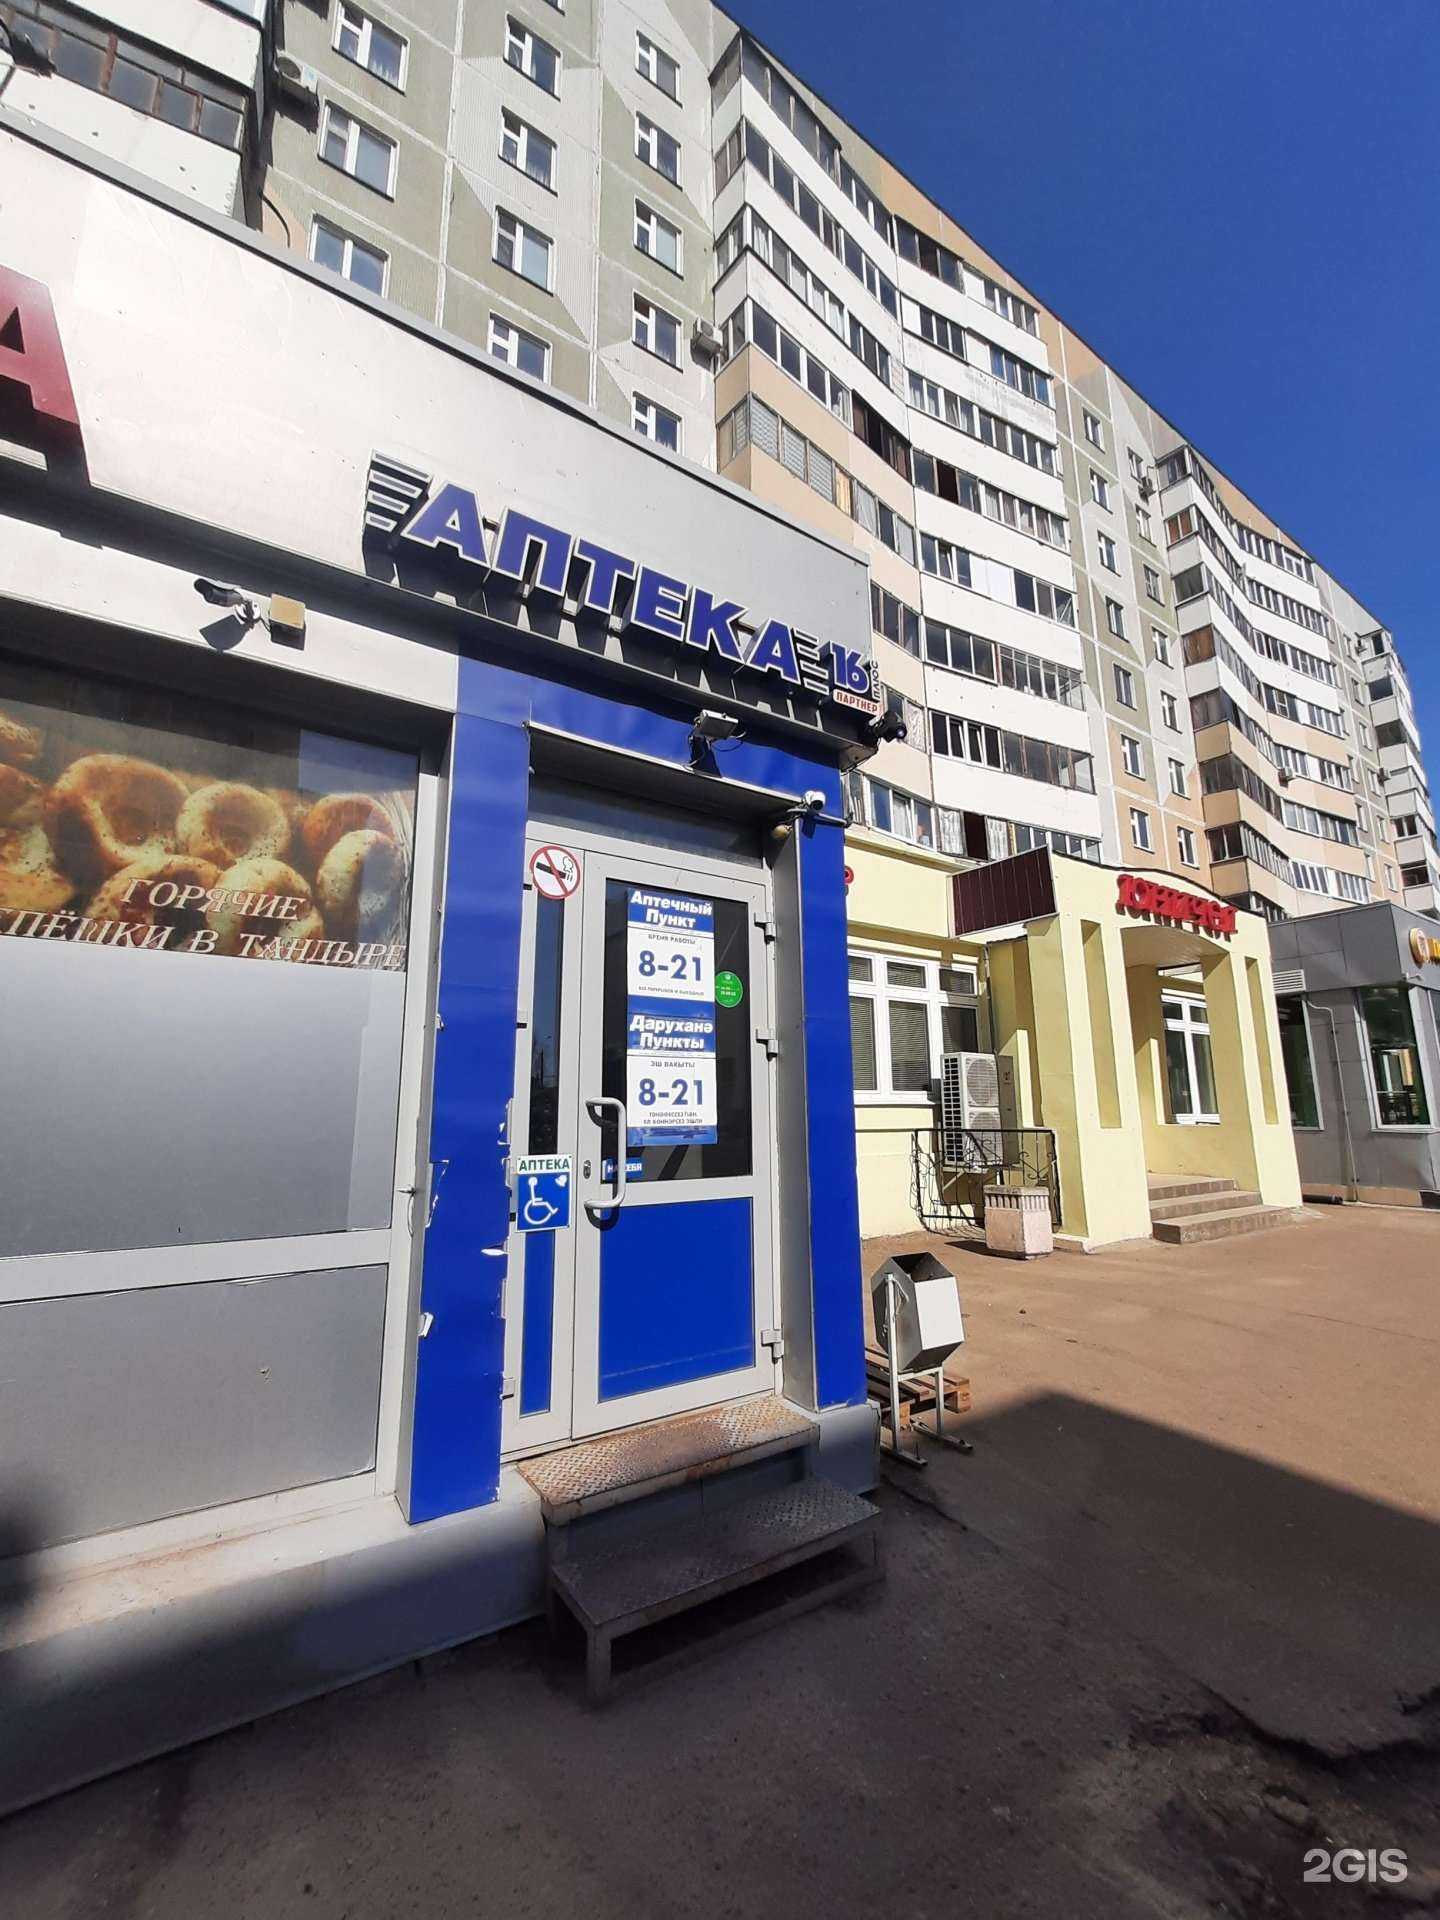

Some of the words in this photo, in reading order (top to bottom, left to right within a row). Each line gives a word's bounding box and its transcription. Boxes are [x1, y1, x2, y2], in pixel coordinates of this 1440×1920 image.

[402, 480, 801, 685] АПТЕКА
[830, 640, 869, 693] 16
[836, 691, 878, 713] ПАРТНЕР
[120, 878, 307, 921] ГОРЯЧИЕ
[630, 890, 713, 916] Аптечный
[645, 908, 696, 928] Пункт
[0, 907, 175, 950] ПЁШКИ
[189, 929, 219, 954] В
[237, 933, 407, 967] ТАНДЫРЕ
[638, 950, 701, 981] 8-21
[629, 1015, 714, 1033] Даруханә
[640, 1032, 705, 1050] Пункты
[638, 1078, 703, 1106] 8-21
[519, 1158, 570, 1171] АПТЕКА
